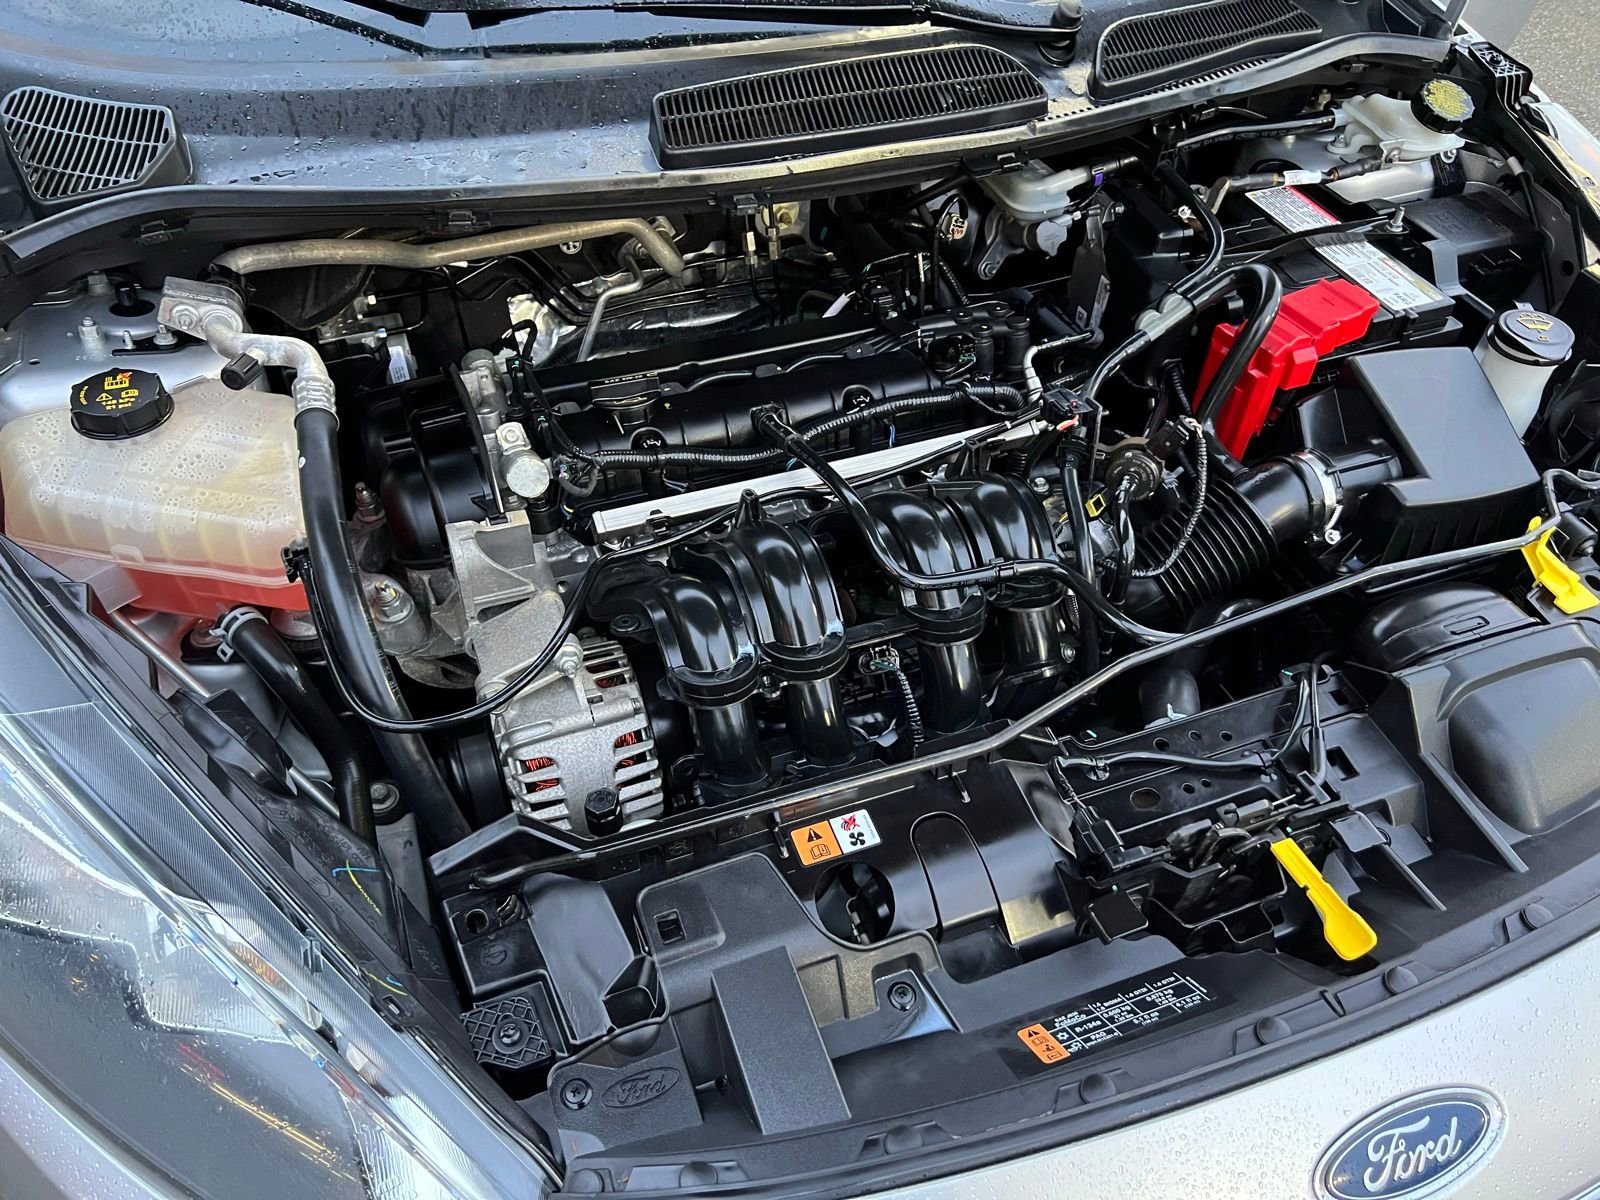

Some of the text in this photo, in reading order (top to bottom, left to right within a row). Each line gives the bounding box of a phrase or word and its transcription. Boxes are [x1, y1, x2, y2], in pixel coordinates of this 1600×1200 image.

[1054, 1014, 1086, 1027] FoMoCo
[1075, 1020, 1102, 1033] R-134a
[1090, 1031, 1106, 1040] PAG
[617, 1074, 665, 1103] Ford
[1363, 1115, 1462, 1192] Ford
